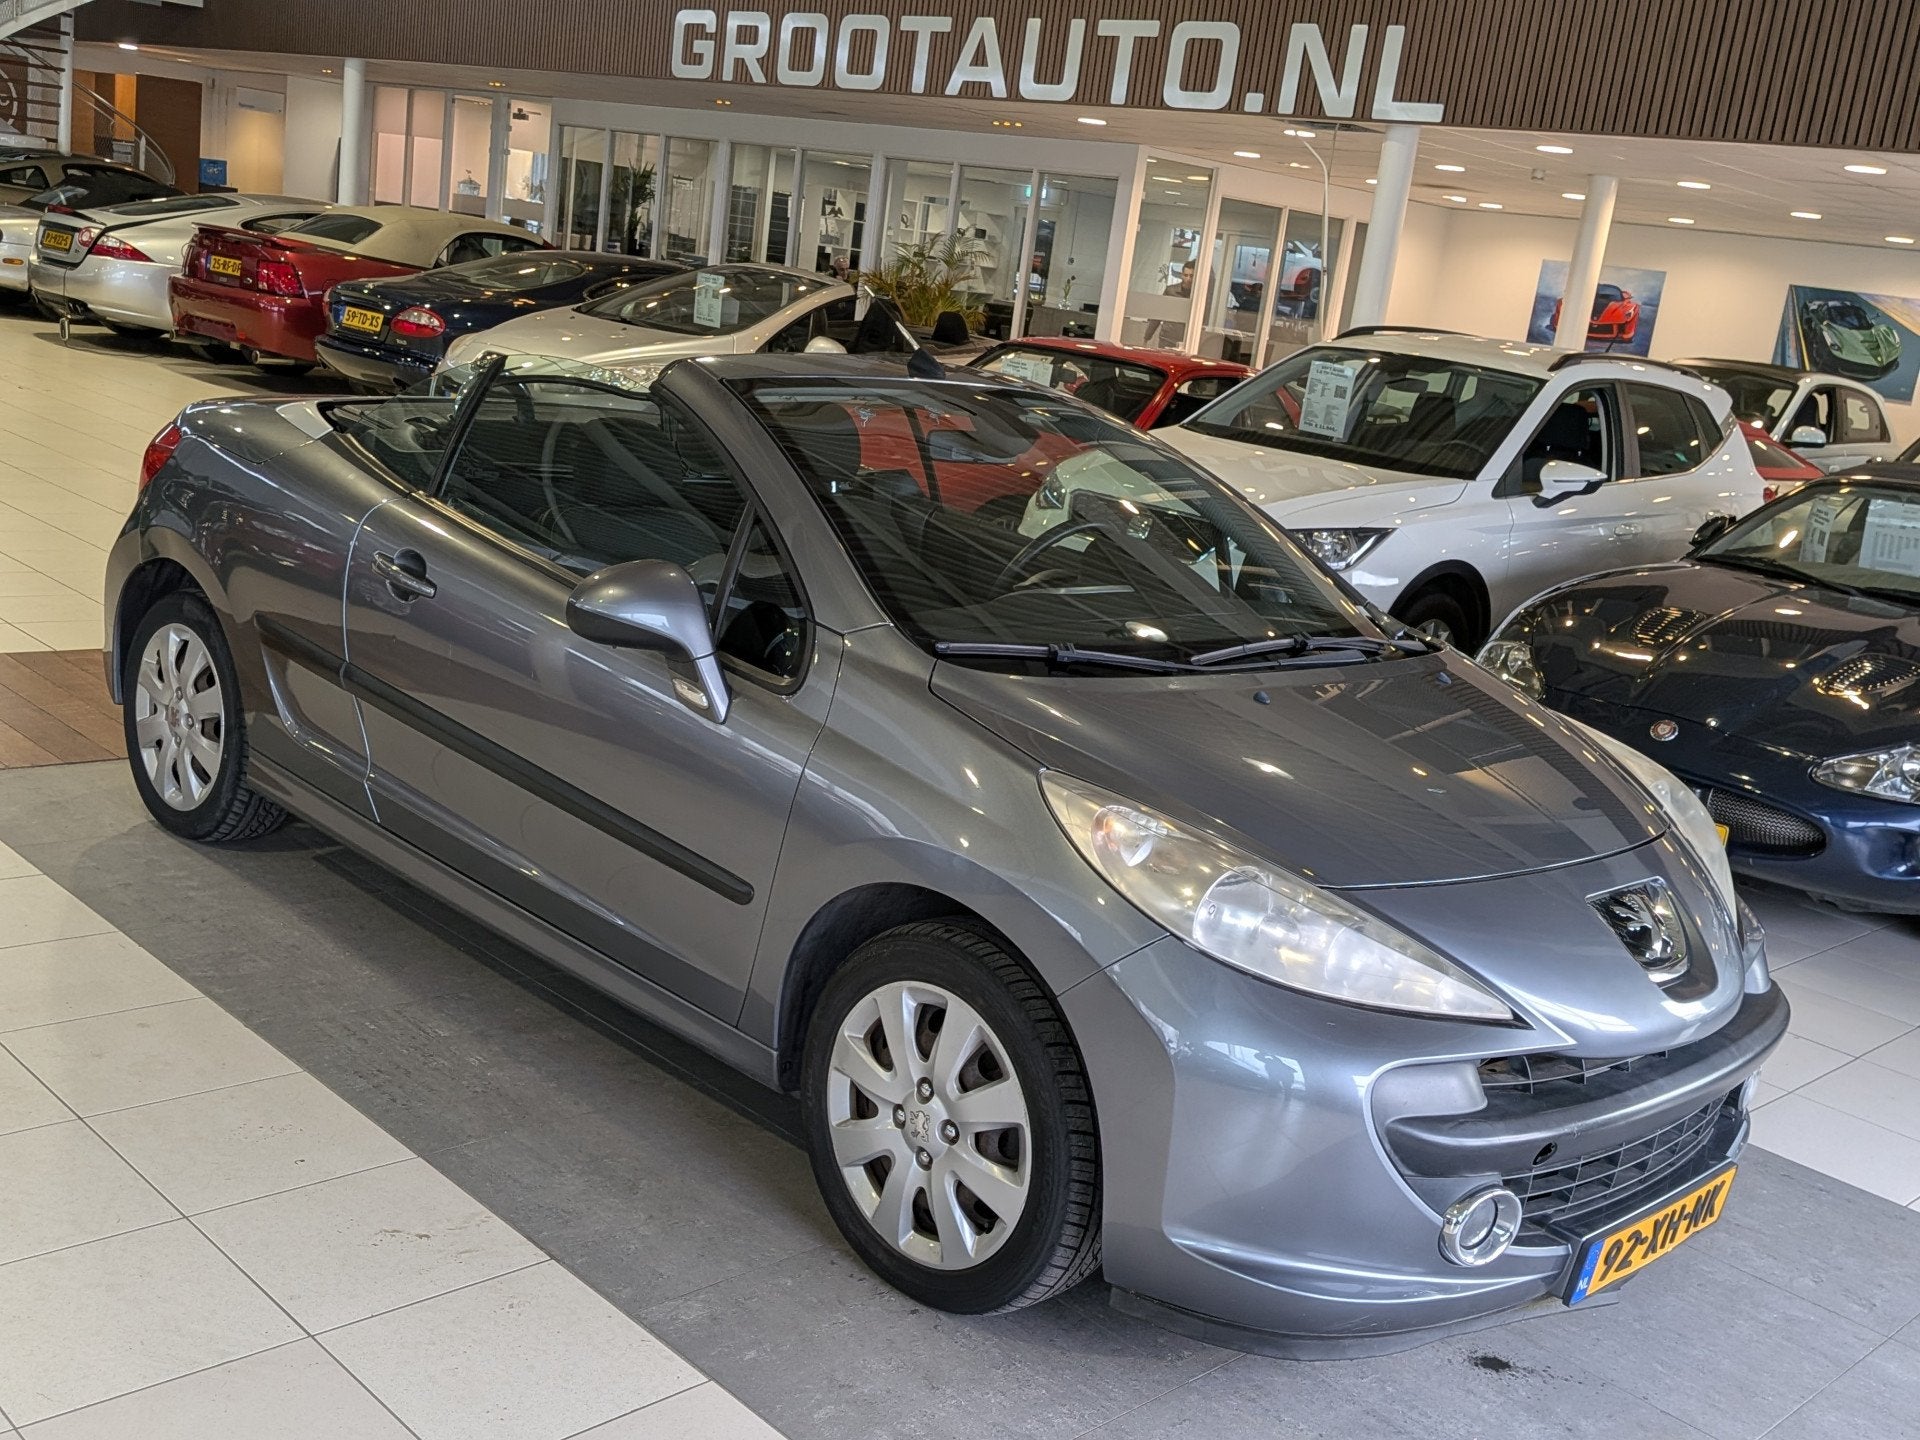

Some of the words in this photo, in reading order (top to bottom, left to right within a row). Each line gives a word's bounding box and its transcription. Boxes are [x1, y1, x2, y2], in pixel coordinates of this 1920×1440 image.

[671, 9, 1444, 122] GROOTAUTO.NL
[345, 309, 381, 329] 59-TD-XS
[1599, 1180, 1726, 1282] 92-XH-NK
[1576, 1276, 1589, 1293] NL
